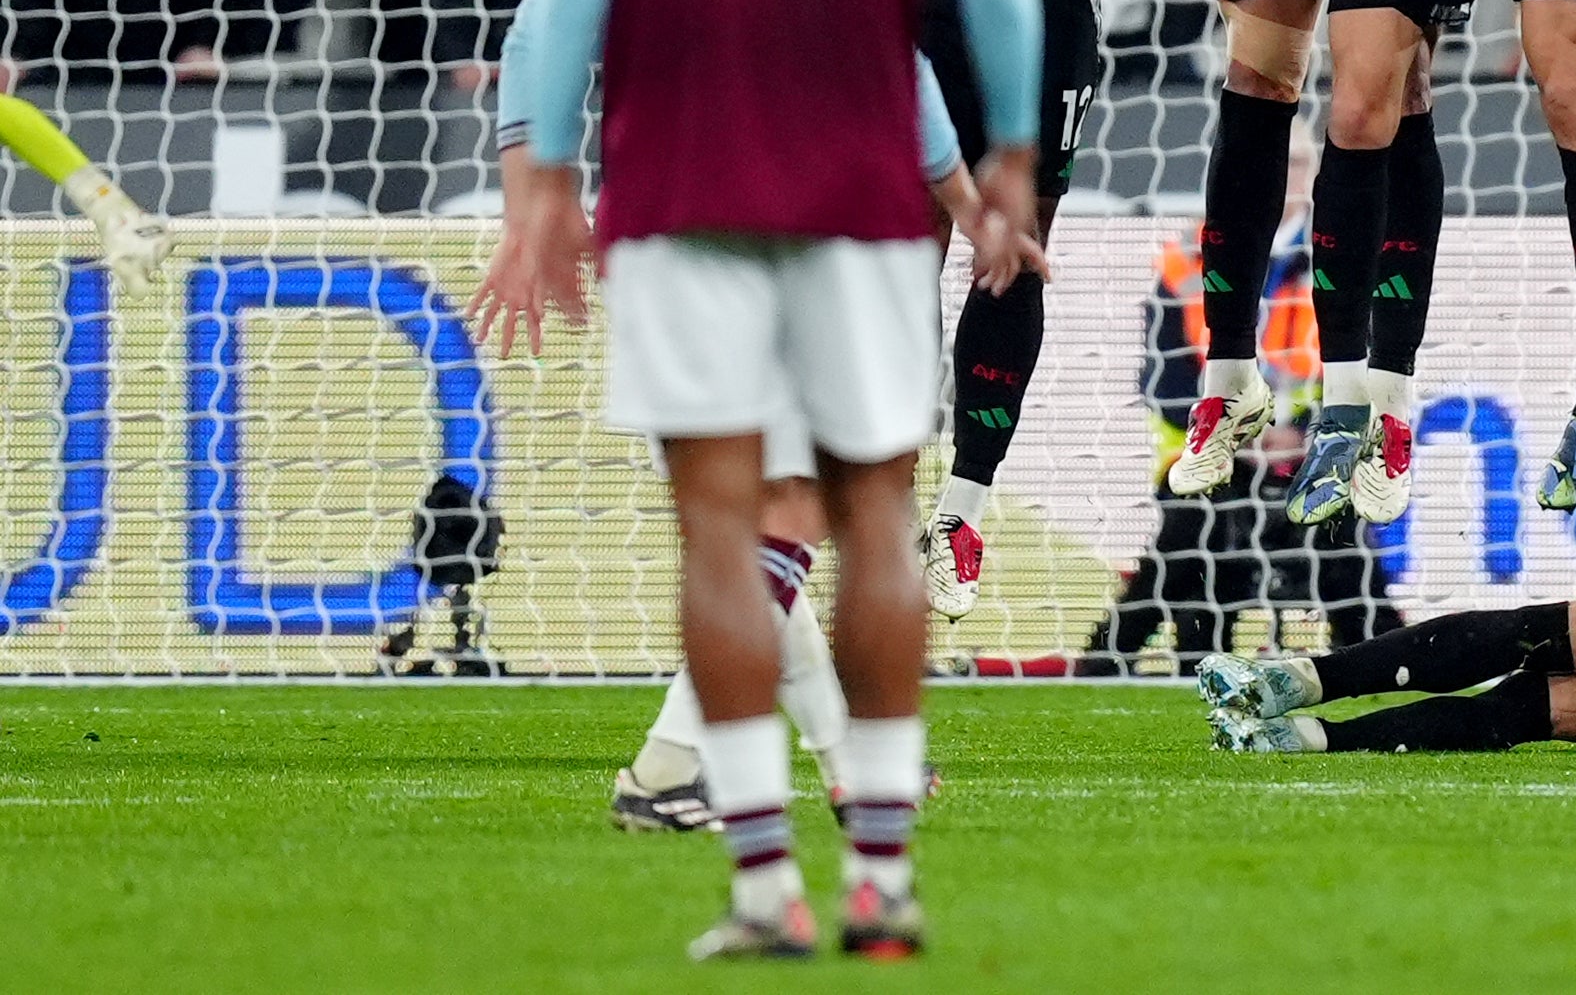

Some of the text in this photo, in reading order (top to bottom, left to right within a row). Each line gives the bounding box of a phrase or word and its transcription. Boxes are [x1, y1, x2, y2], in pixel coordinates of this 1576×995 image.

[1202, 228, 1225, 246] FC
[1313, 230, 1338, 249] FC
[1382, 240, 1420, 253] FC
